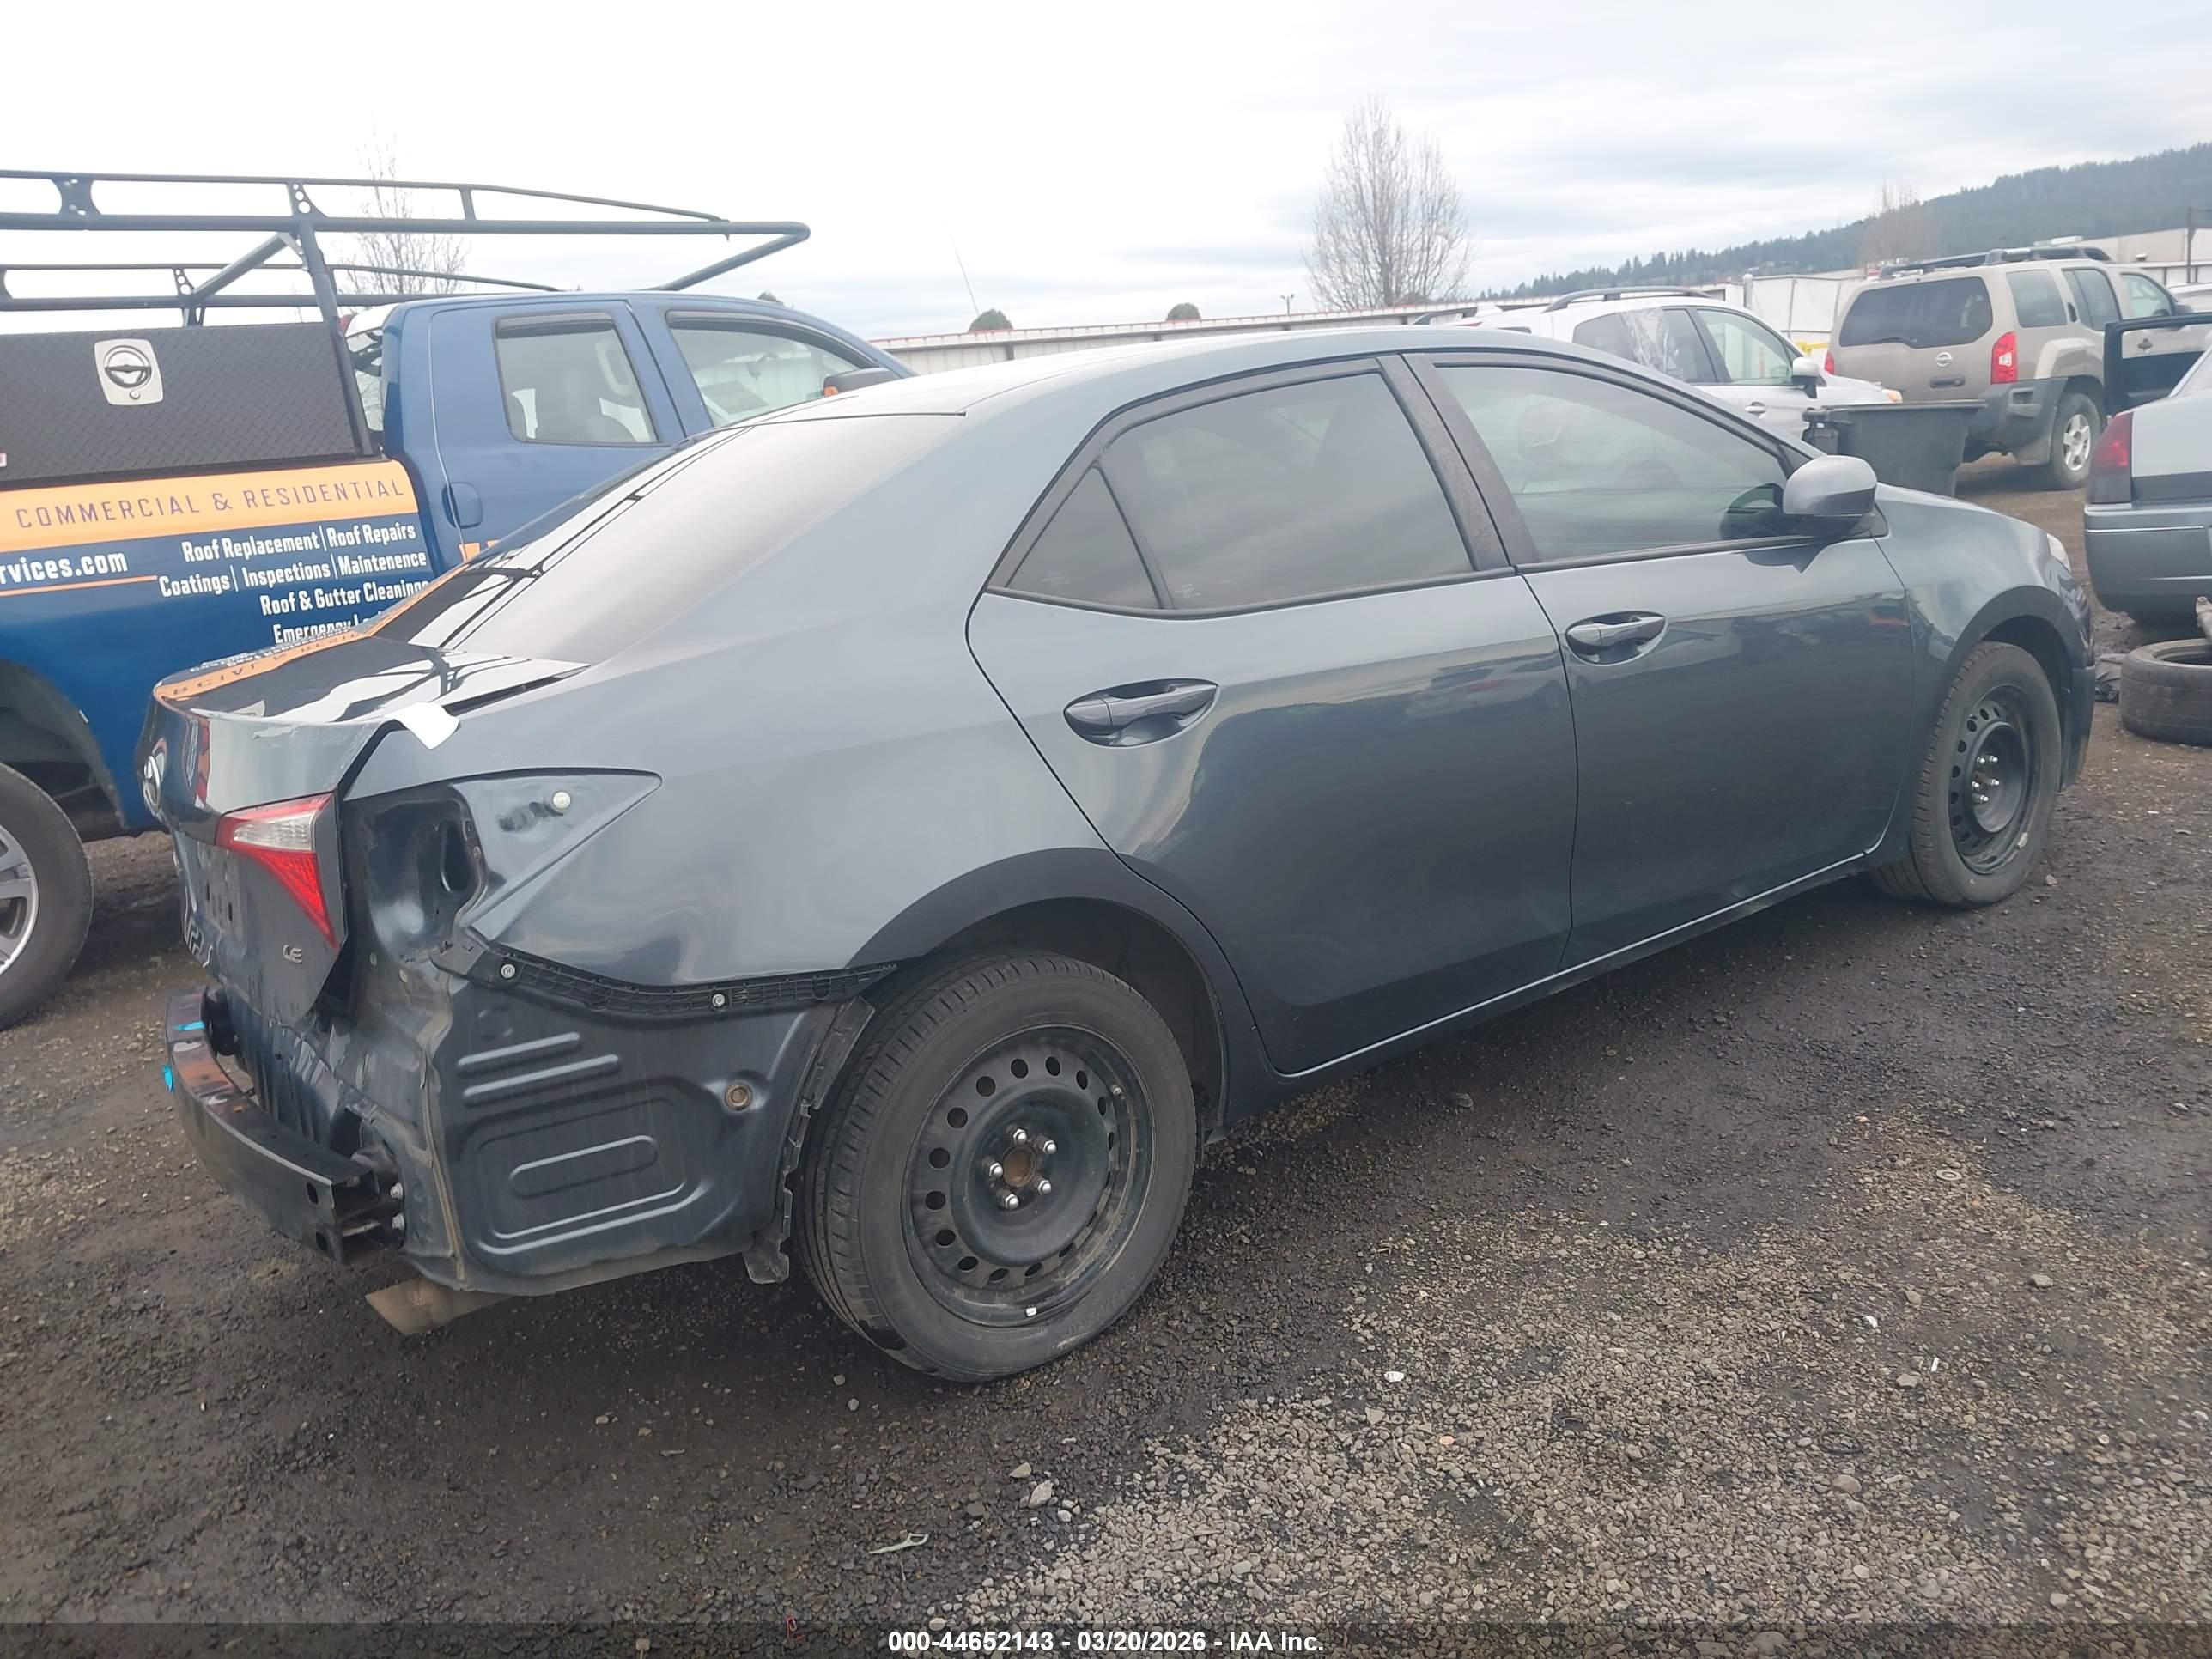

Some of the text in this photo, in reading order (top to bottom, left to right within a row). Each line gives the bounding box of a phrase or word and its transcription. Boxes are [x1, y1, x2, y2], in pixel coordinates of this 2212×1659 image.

[16, 478, 404, 528] COMMERCIAL & RESIDENTIAL
[181, 521, 416, 562] Roof Replacement Roof Repairs
[159, 551, 427, 597] Coatings Inspections Maintenence
[259, 591, 296, 617] Roof
[298, 590, 313, 611] &
[314, 586, 362, 609] Gutter
[282, 944, 303, 964] LE
